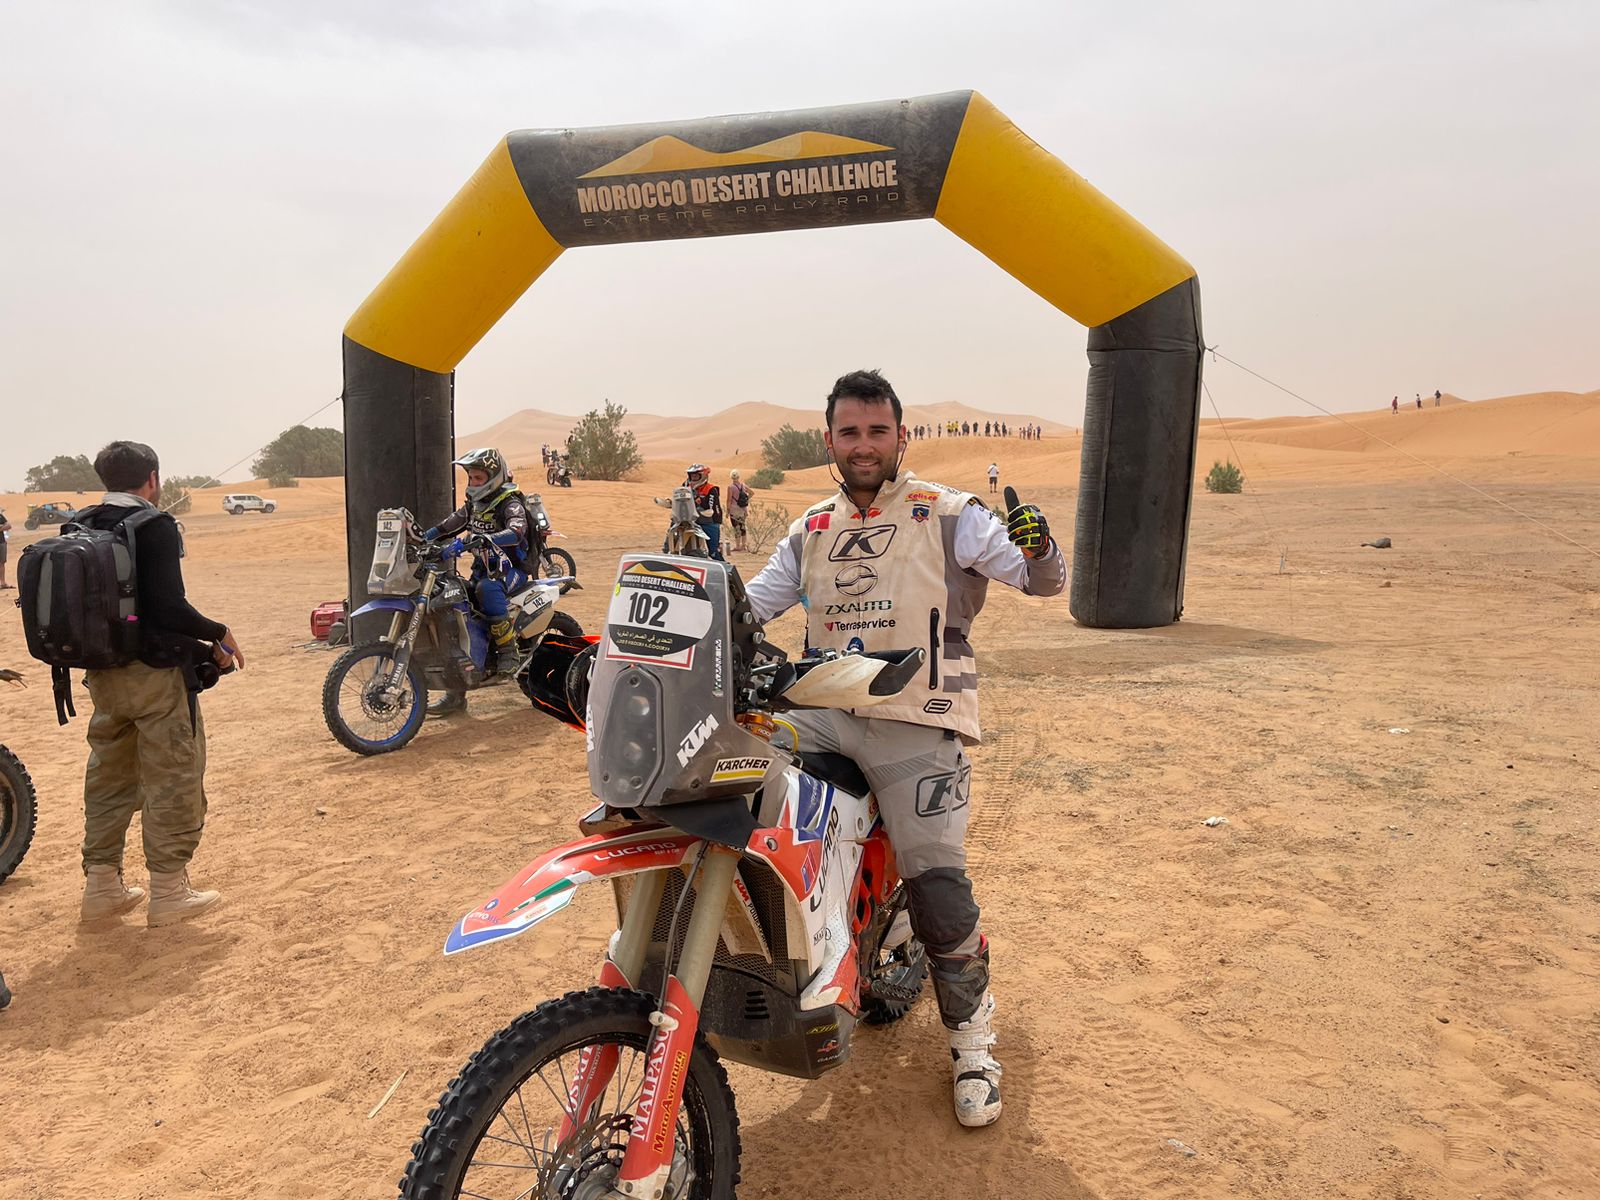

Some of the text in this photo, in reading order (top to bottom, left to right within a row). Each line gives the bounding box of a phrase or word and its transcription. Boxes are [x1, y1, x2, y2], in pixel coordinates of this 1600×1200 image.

[577, 159, 899, 214] MOROCCO DESERT CHALLENGE
[583, 192, 900, 227] EXTREME RALLY-RAID
[661, 578, 696, 592] CHALLENGE
[628, 592, 670, 628] 102
[824, 600, 892, 615] ZXAUTO
[834, 618, 896, 632] Terraservice
[676, 713, 720, 768] KTM
[716, 758, 770, 773] KÄRCHER
[594, 842, 677, 861] LUCANO
[809, 804, 840, 913] LUCANO
[653, 1049, 687, 1153] MotoAventura
